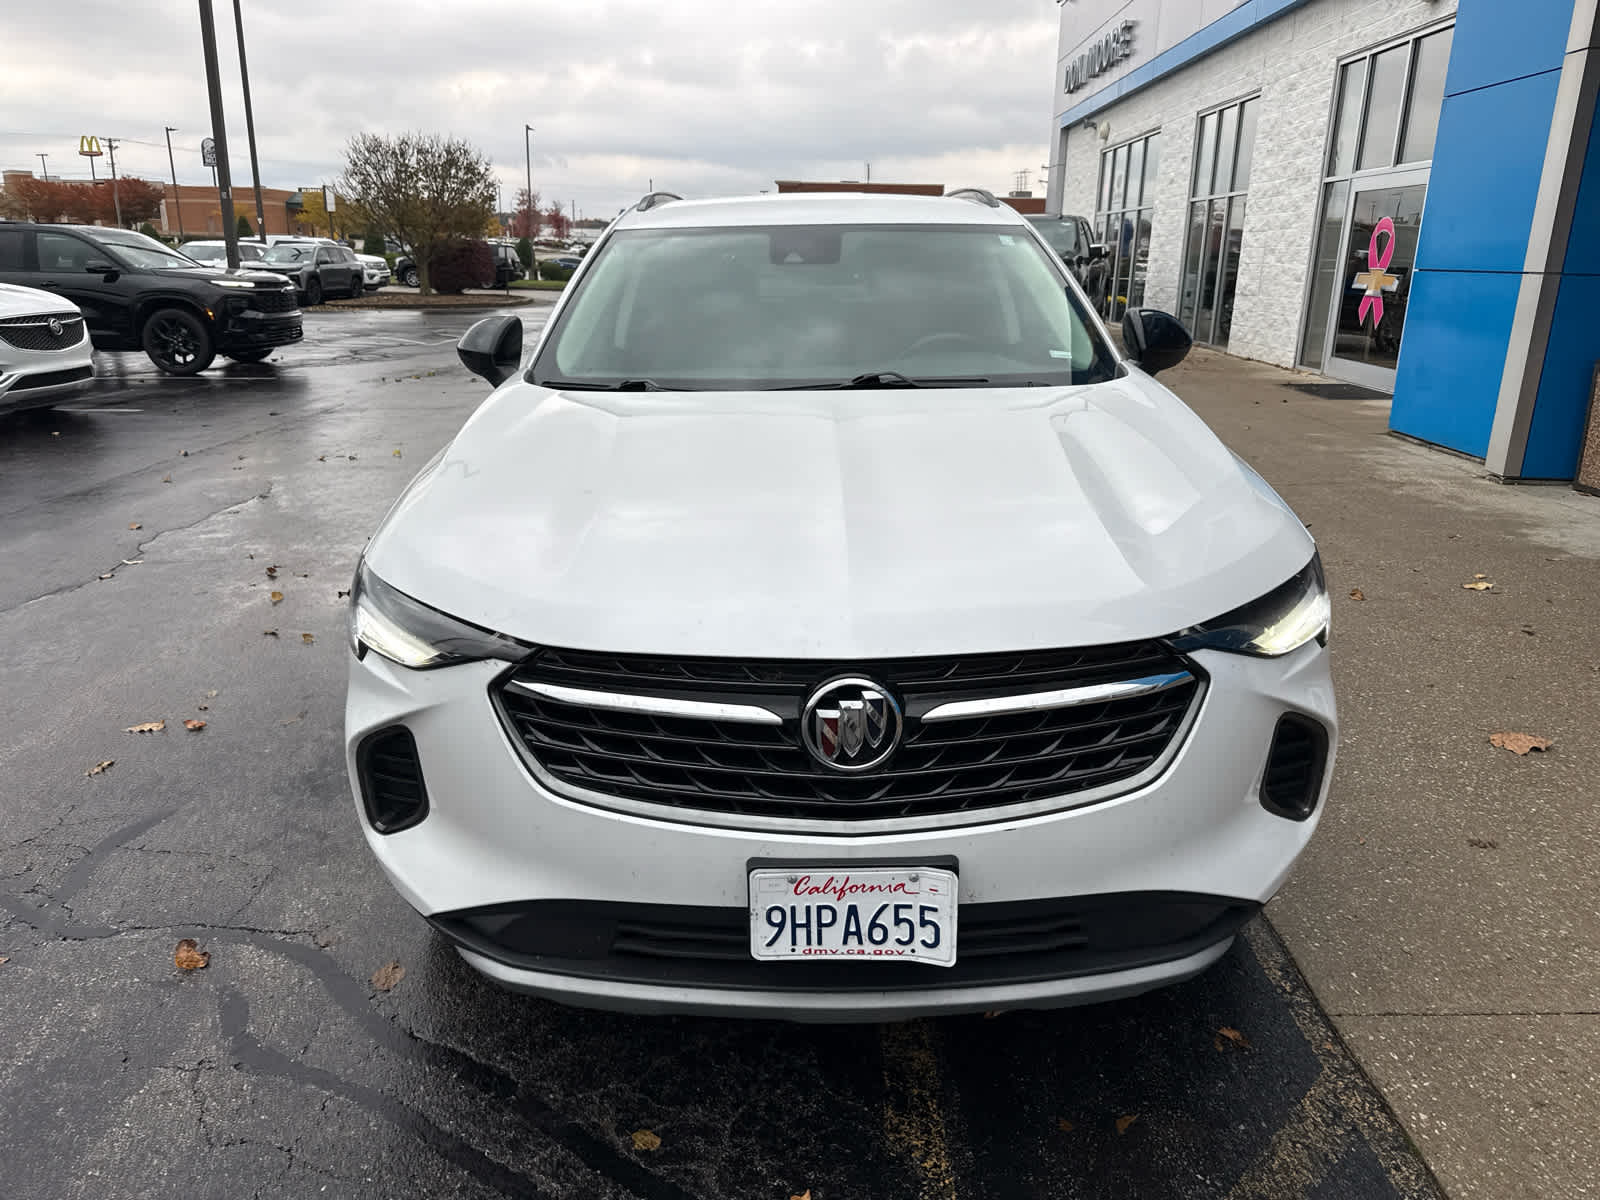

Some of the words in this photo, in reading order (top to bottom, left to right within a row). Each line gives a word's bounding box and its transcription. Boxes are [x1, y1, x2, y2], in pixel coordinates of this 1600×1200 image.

[80, 136, 101, 152] M
[794, 876, 920, 901] California
[765, 903, 941, 949] 9HPA655
[802, 948, 905, 956] dmv.ca.gov
